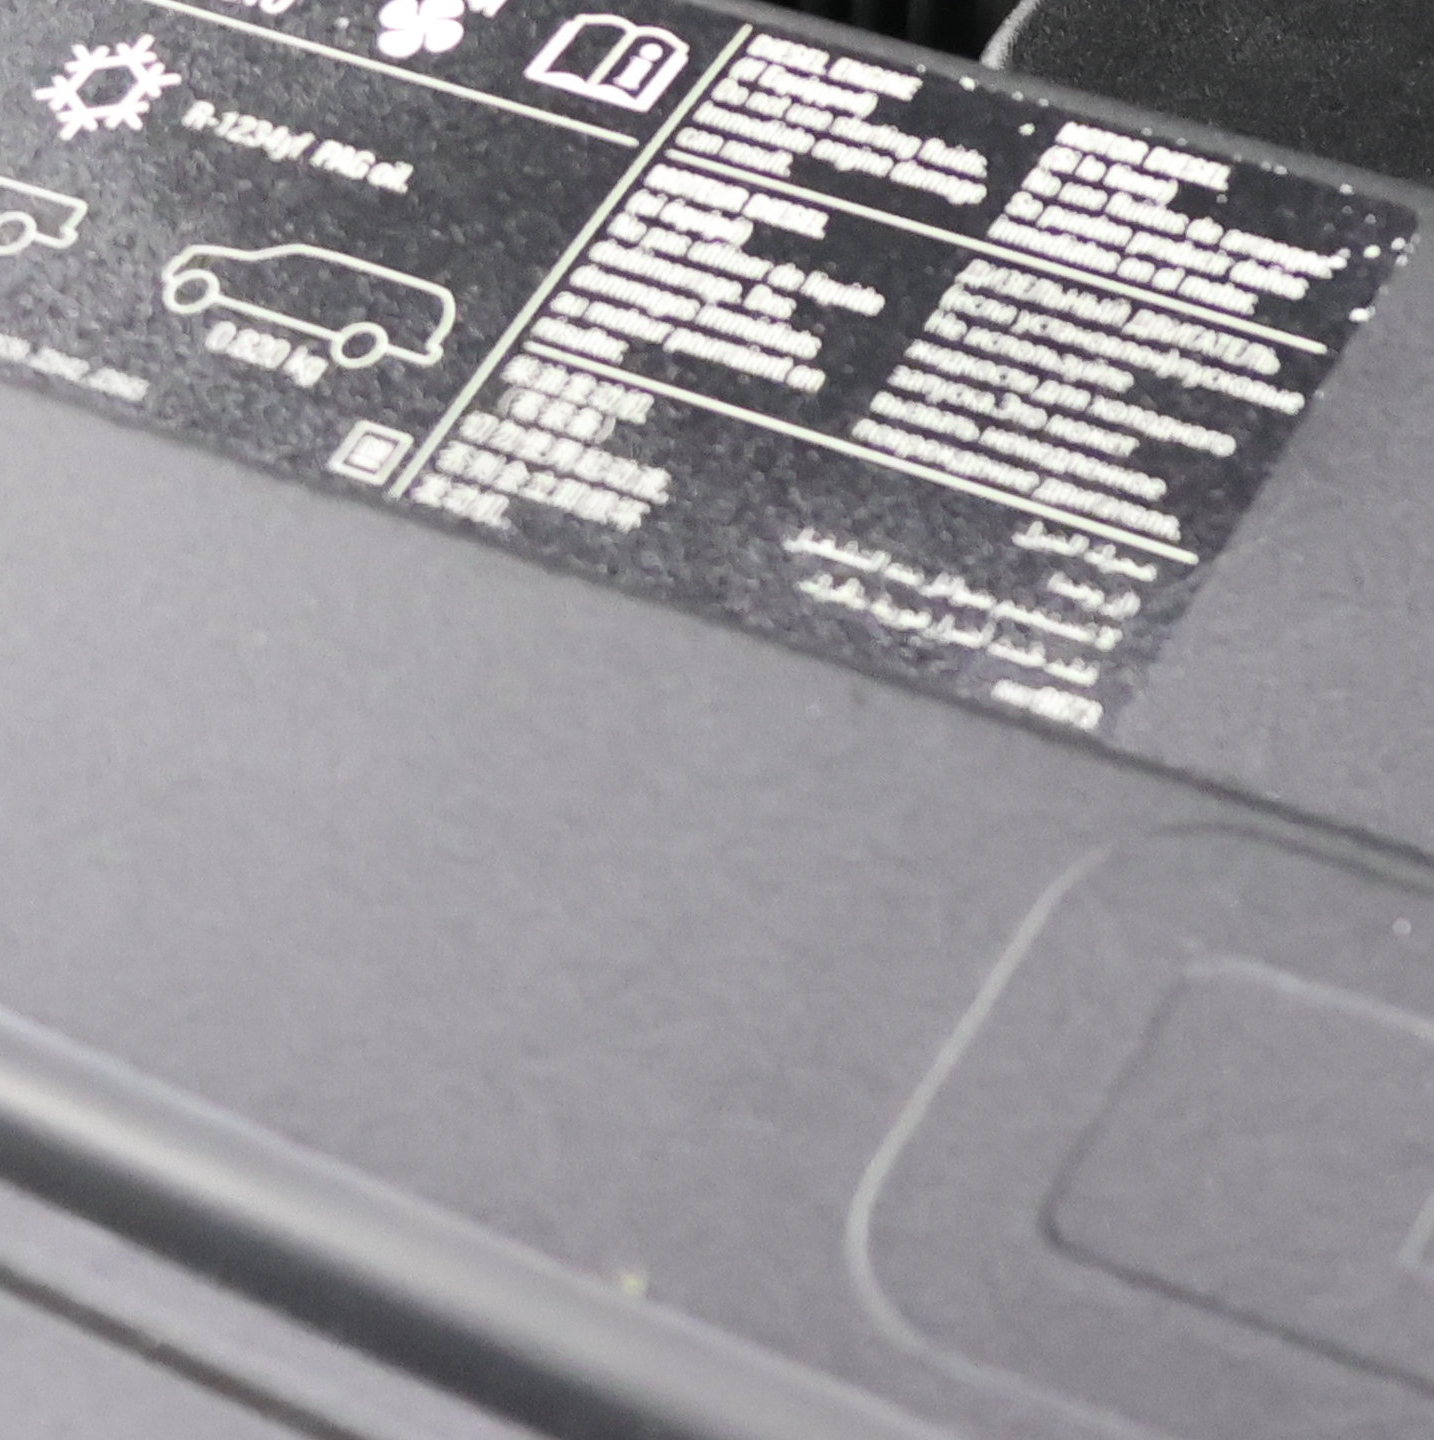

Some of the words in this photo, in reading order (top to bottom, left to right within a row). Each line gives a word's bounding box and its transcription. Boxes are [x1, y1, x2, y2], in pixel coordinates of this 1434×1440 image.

[746, 33, 829, 76] DIESEL
[827, 57, 922, 100] ENGINE
[181, 100, 316, 162] R-1234yf
[1055, 121, 1149, 165] MOTOR
[1142, 146, 1230, 190] DIESEL
[643, 163, 749, 212] MOTEUR
[740, 192, 828, 238] DIESEL
